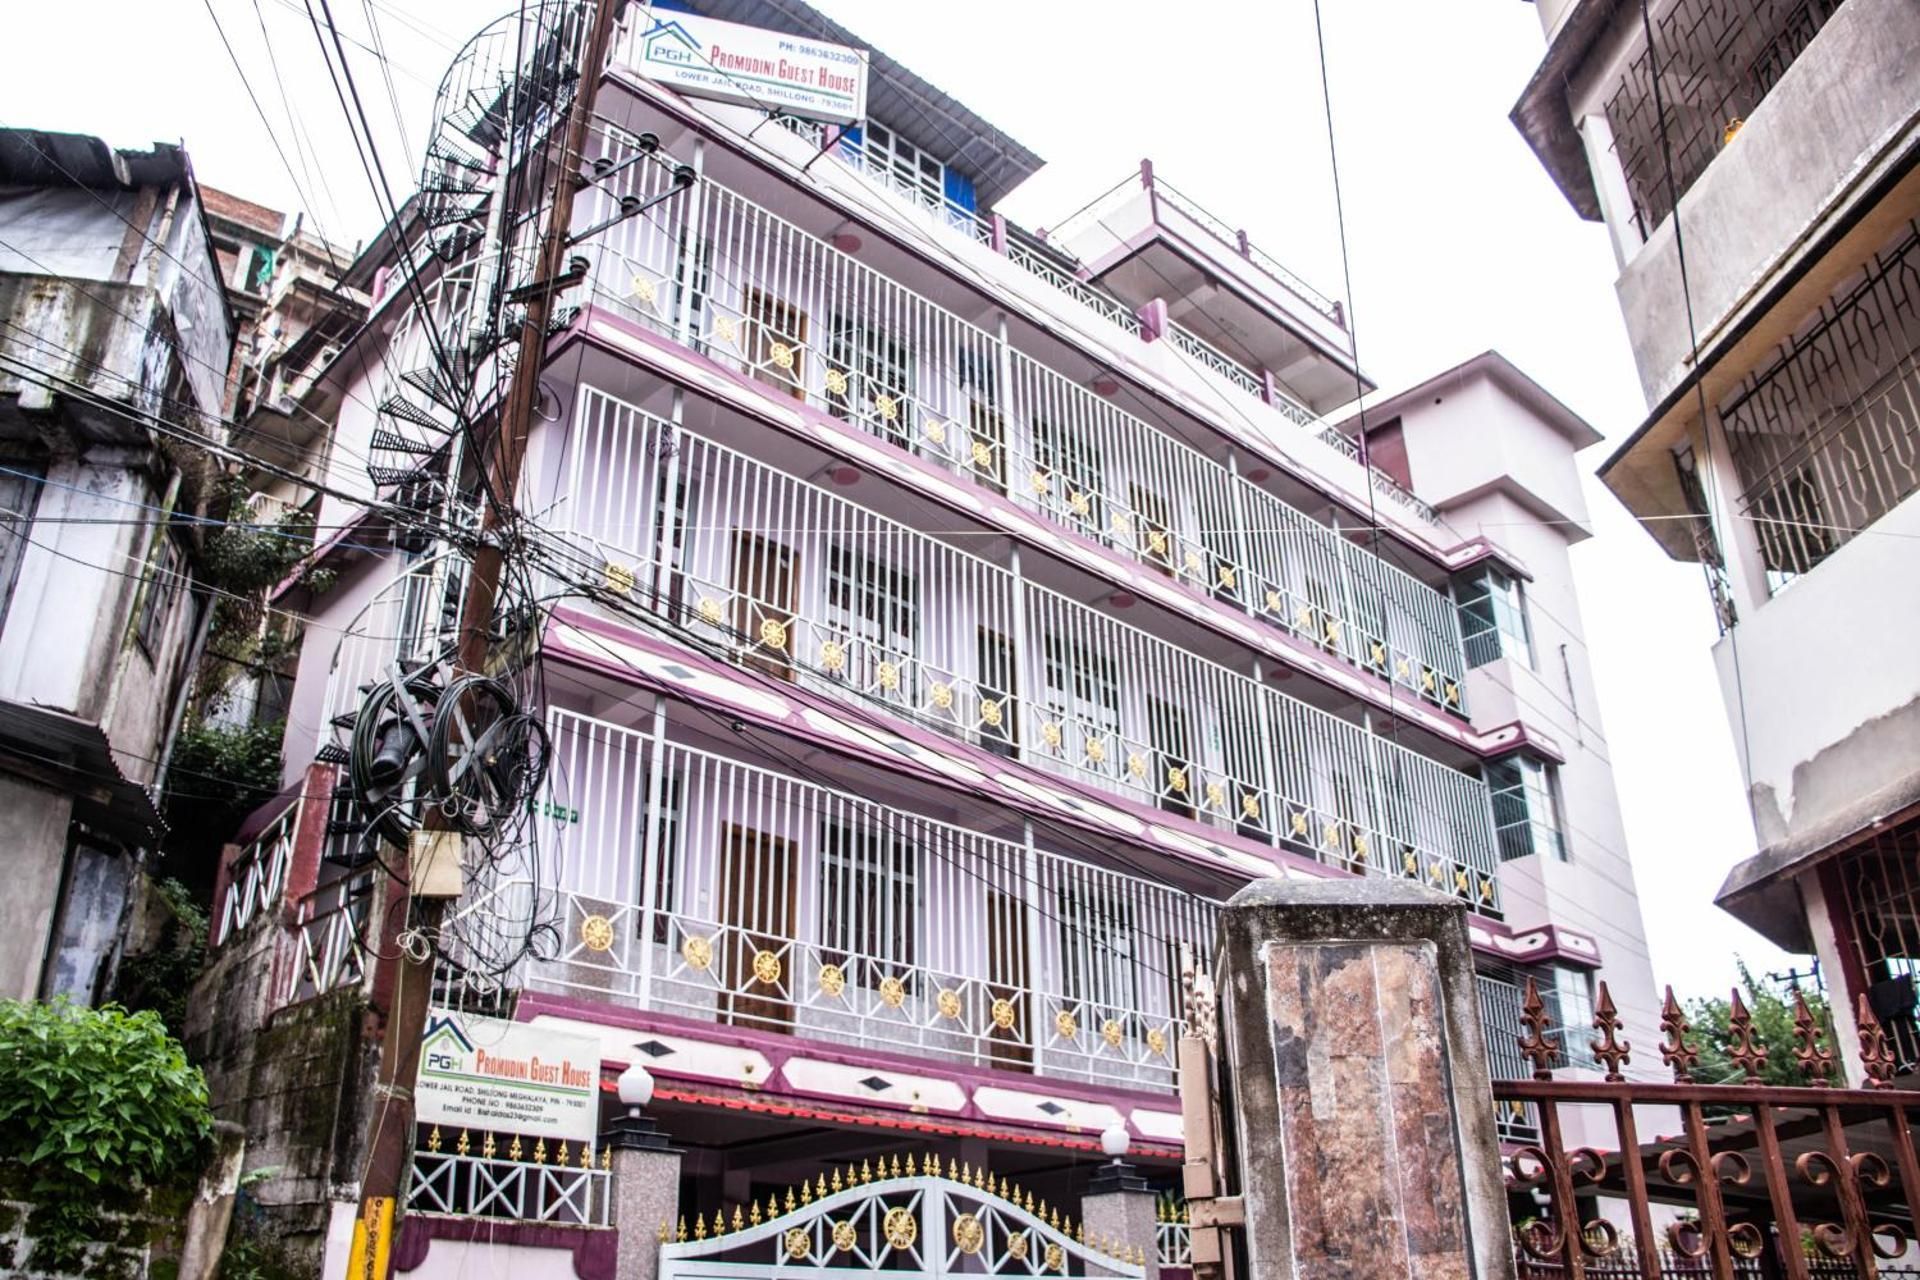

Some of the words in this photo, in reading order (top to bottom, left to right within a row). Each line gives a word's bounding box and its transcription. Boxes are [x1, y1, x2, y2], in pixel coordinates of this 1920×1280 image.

[654, 46, 691, 62] PGH
[778, 58, 814, 84] GUEST
[819, 66, 855, 93] HOUSE
[675, 70, 709, 83] LOWER
[712, 77, 732, 88] JAIL
[767, 87, 815, 103] SHILLONG
[428, 1052, 463, 1071] PGH
[530, 1056, 559, 1083] GUEST
[562, 1060, 591, 1088] HOUSE
[443, 1103, 462, 1113] Email
[462, 1096, 485, 1106] PHONE
